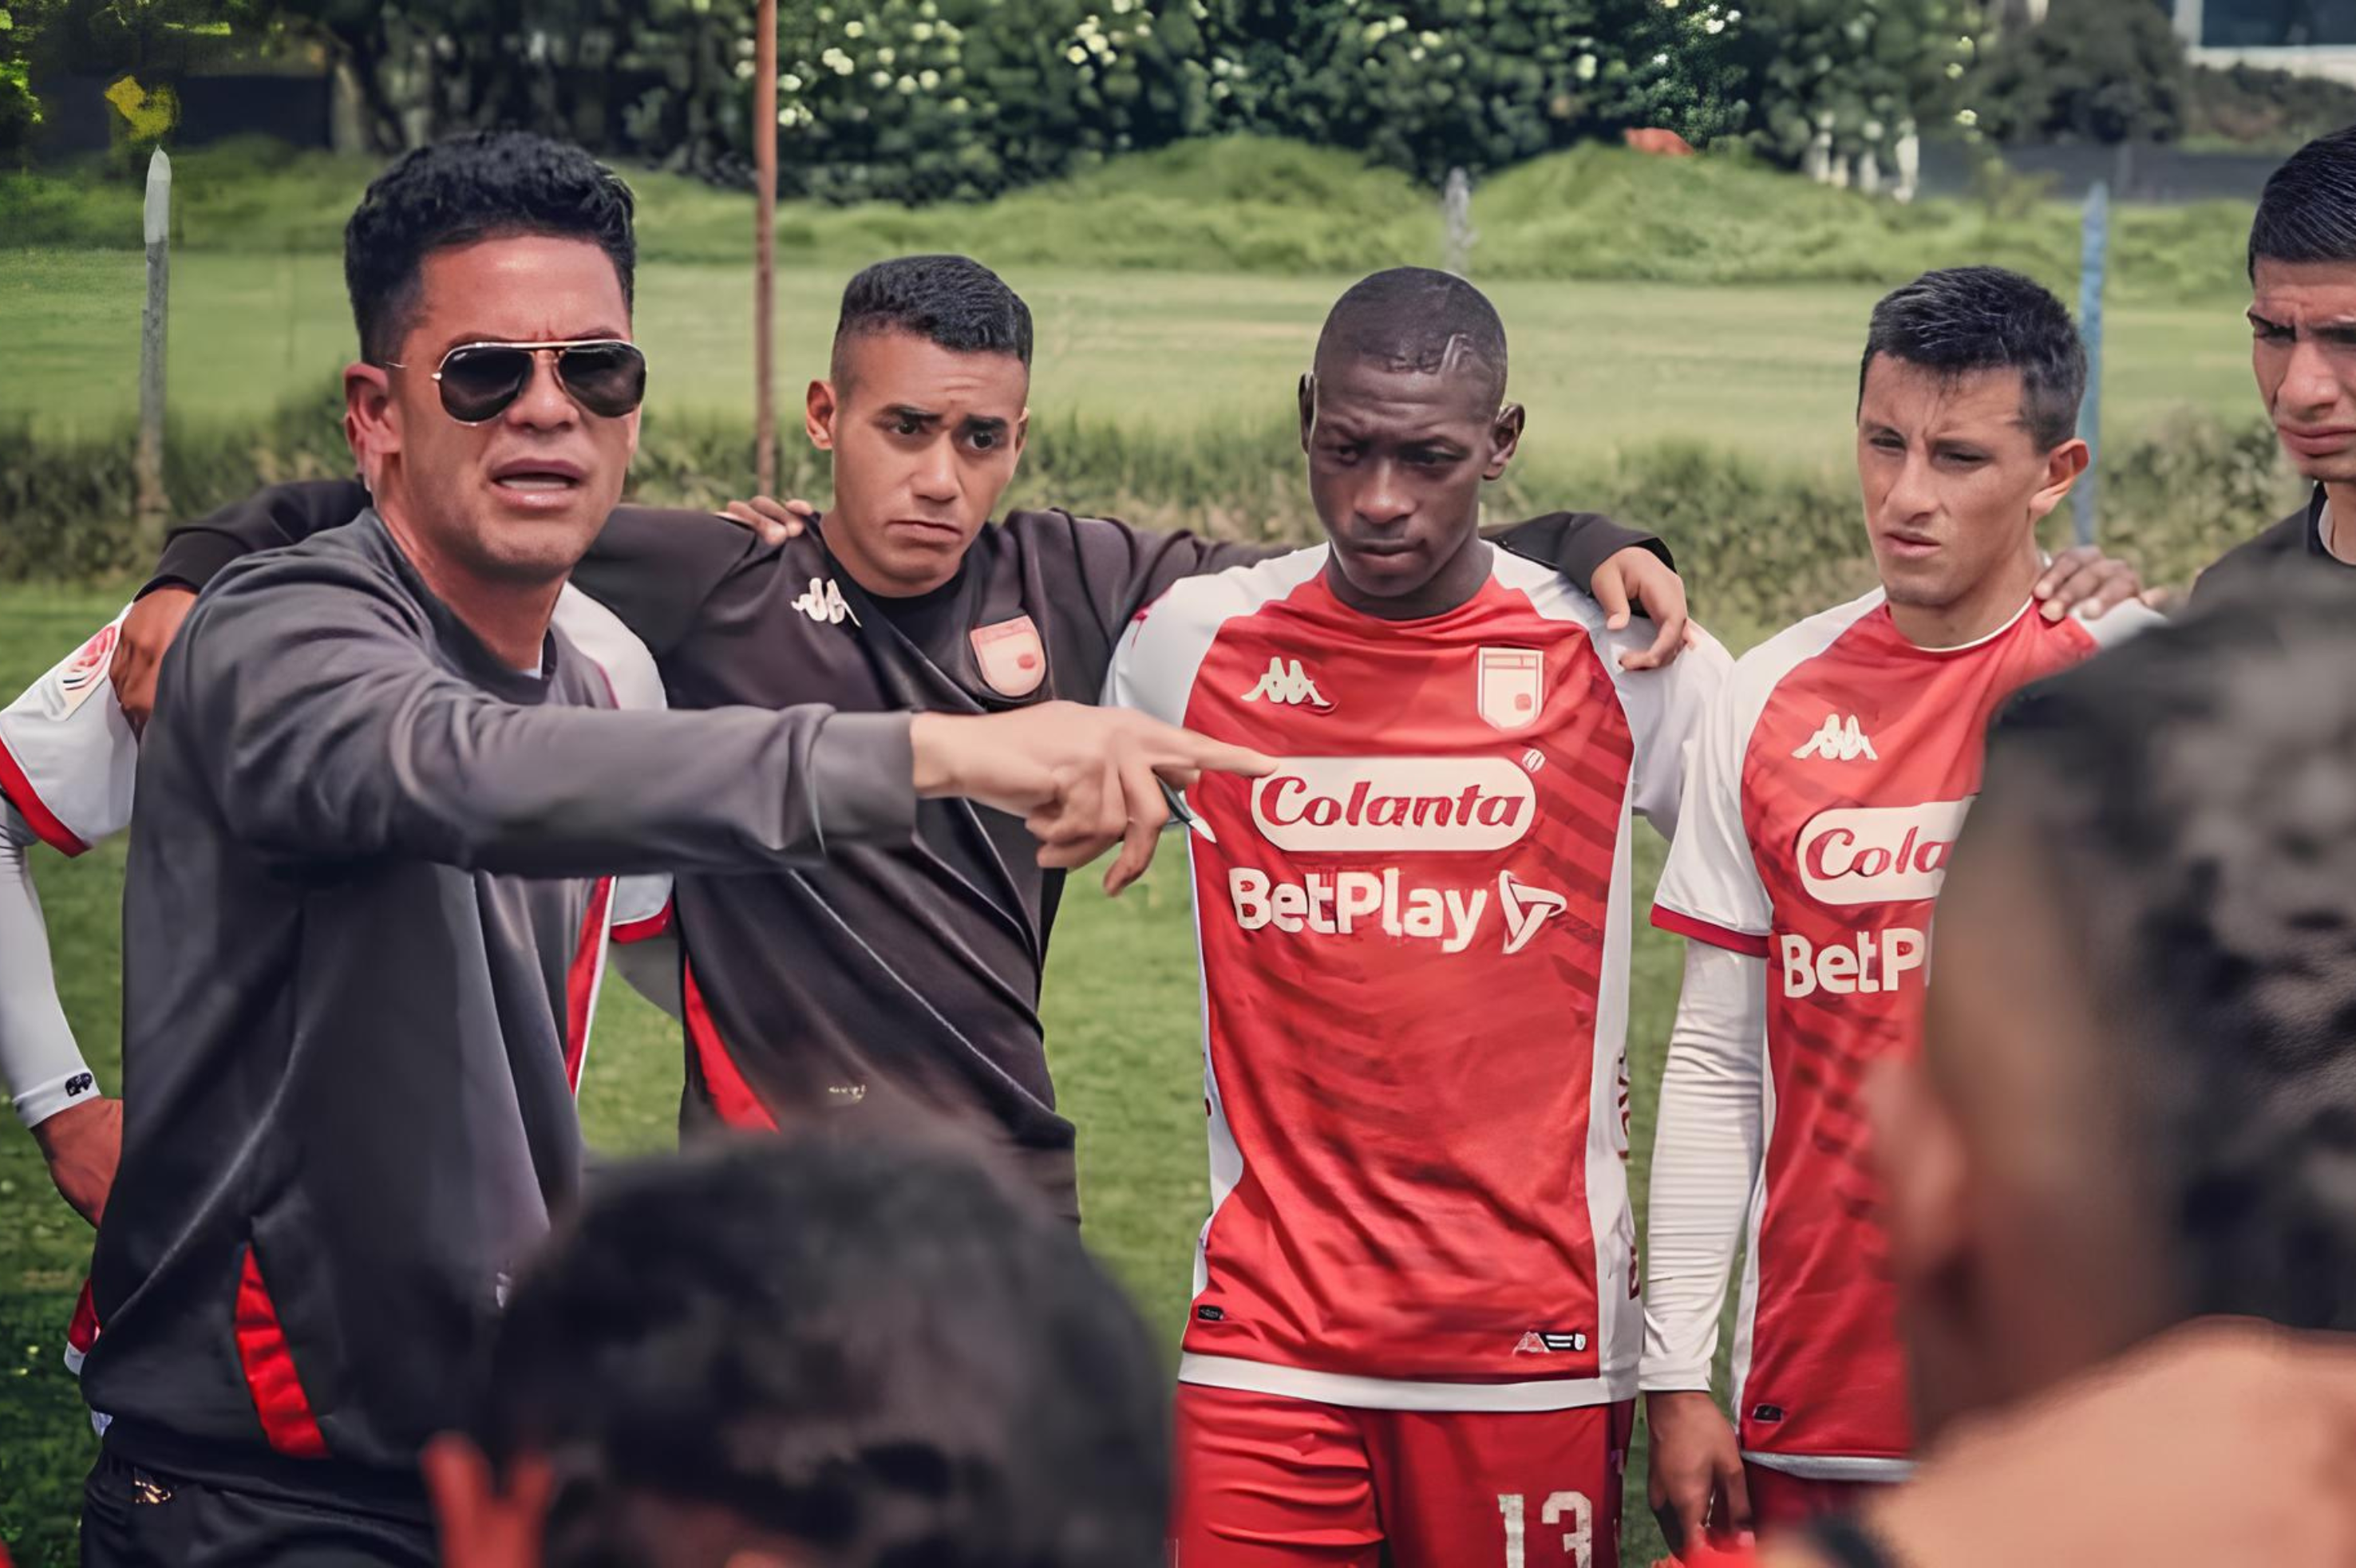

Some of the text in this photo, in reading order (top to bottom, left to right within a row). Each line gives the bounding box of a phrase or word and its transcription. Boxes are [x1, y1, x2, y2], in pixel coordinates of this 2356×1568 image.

[1259, 776, 1525, 827] Colanta
[1227, 867, 1488, 953] BetPlay
[1497, 1491, 1592, 1568] 13
